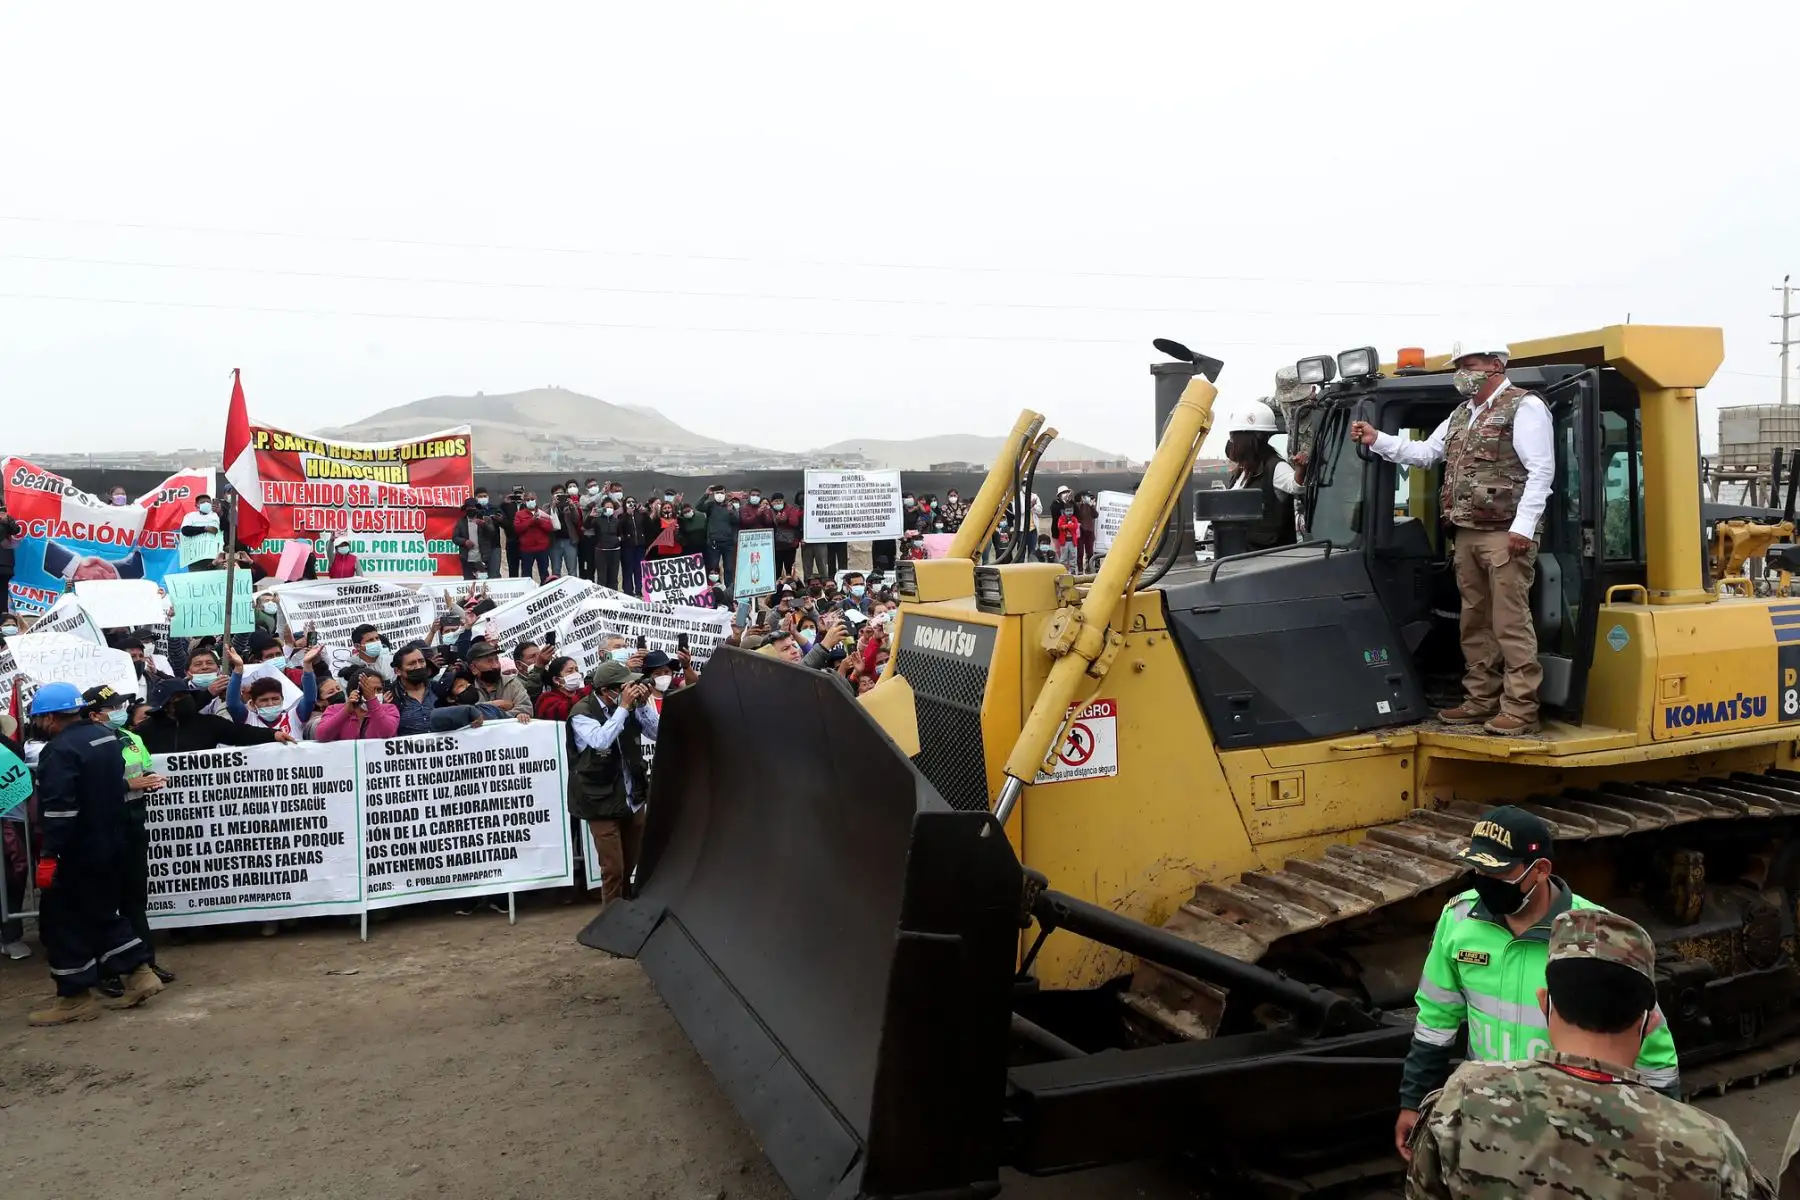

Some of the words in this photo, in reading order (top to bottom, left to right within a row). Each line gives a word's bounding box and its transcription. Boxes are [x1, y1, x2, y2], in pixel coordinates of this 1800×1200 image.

[273, 433, 326, 457] SANTA
[329, 444, 374, 461] ROSA
[377, 447, 399, 461] DE
[400, 438, 466, 460] OLLEROS
[260, 481, 345, 506] ENVENIDO
[348, 484, 374, 506] SR.
[377, 485, 470, 507] PRESIDENTE
[293, 508, 347, 532] PEDRO
[352, 509, 427, 532] CASTILLO
[372, 540, 398, 553] POR
[401, 540, 425, 553] LAS
[642, 554, 704, 578] NUESTRO
[336, 584, 382, 597] SEÑORES:
[645, 571, 705, 594] COLEGIO
[526, 589, 567, 615] SEÑORES:
[618, 611, 651, 625] URGENTE
[651, 616, 661, 627] UN
[662, 617, 690, 630] CENTRO
[691, 621, 701, 631] DE
[701, 622, 723, 635] SALUD
[631, 625, 640, 636] EL
[699, 634, 710, 646] DEL
[913, 624, 977, 658] KOMATSU
[1784, 668, 1797, 687] D
[1665, 692, 1767, 729] KOMATSU
[384, 736, 459, 756] SEÑORES:
[167, 751, 248, 772] SEÑORES:
[384, 757, 427, 772] URGENTE
[429, 755, 443, 769] UN
[445, 751, 482, 767] CENTRO
[485, 749, 496, 762] DE
[498, 746, 529, 761] SALUD
[1098, 764, 1116, 774] segura
[216, 772, 231, 785] UN
[233, 769, 273, 783] CENTRO
[277, 768, 289, 781] DE
[291, 766, 324, 780] SALUD
[405, 774, 415, 787] EL
[417, 764, 497, 786] ENCAUZAMIENTO
[499, 763, 515, 777] DEL
[519, 758, 557, 774] HUAYCO
[189, 791, 200, 804] EL
[202, 783, 288, 803] ENCAUZAMIENTO
[291, 783, 309, 796] DEL
[312, 779, 353, 795] HUAYCO
[385, 788, 429, 805] URGENTE
[433, 786, 453, 800] LUZ,
[454, 782, 480, 797] AGUA
[481, 781, 488, 794] Y
[490, 775, 532, 793] DESAGÜE
[167, 805, 215, 821] URGENTE
[219, 803, 241, 817] LUZ,
[242, 801, 270, 815] AGUA
[272, 801, 278, 813] Y
[280, 796, 326, 812] DESAGÜE
[425, 805, 438, 819] EL
[440, 794, 534, 818] MEJORAMIENTO
[210, 823, 224, 837] EL
[227, 816, 328, 835] MEJORAMIENTO
[394, 826, 409, 840] DE
[412, 824, 427, 838] LA
[430, 814, 500, 836] CARRETERA
[502, 809, 551, 827] PORQUE
[1471, 820, 1514, 850] POLICIA
[176, 843, 193, 858] DE
[196, 841, 212, 856] LA
[215, 836, 291, 854] CARRETERA
[294, 832, 345, 848] PORQUE
[390, 842, 417, 857] CON
[420, 833, 484, 855] NUESTRAS
[486, 828, 531, 846] FAENAS
[172, 859, 200, 875] CON
[204, 854, 272, 872] NUESTRAS
[275, 850, 323, 868] FAENAS
[446, 846, 518, 868] HABILITADA
[147, 875, 229, 895] ANTENEMOS
[232, 869, 309, 887] HABILITADA
[406, 878, 415, 888] C.
[415, 874, 451, 887] POBLADO
[452, 868, 502, 882] PAMPAPACTA
[188, 899, 197, 908] C.
[198, 895, 237, 907] POBLADO
[239, 891, 292, 903] PAMPAPACTA
